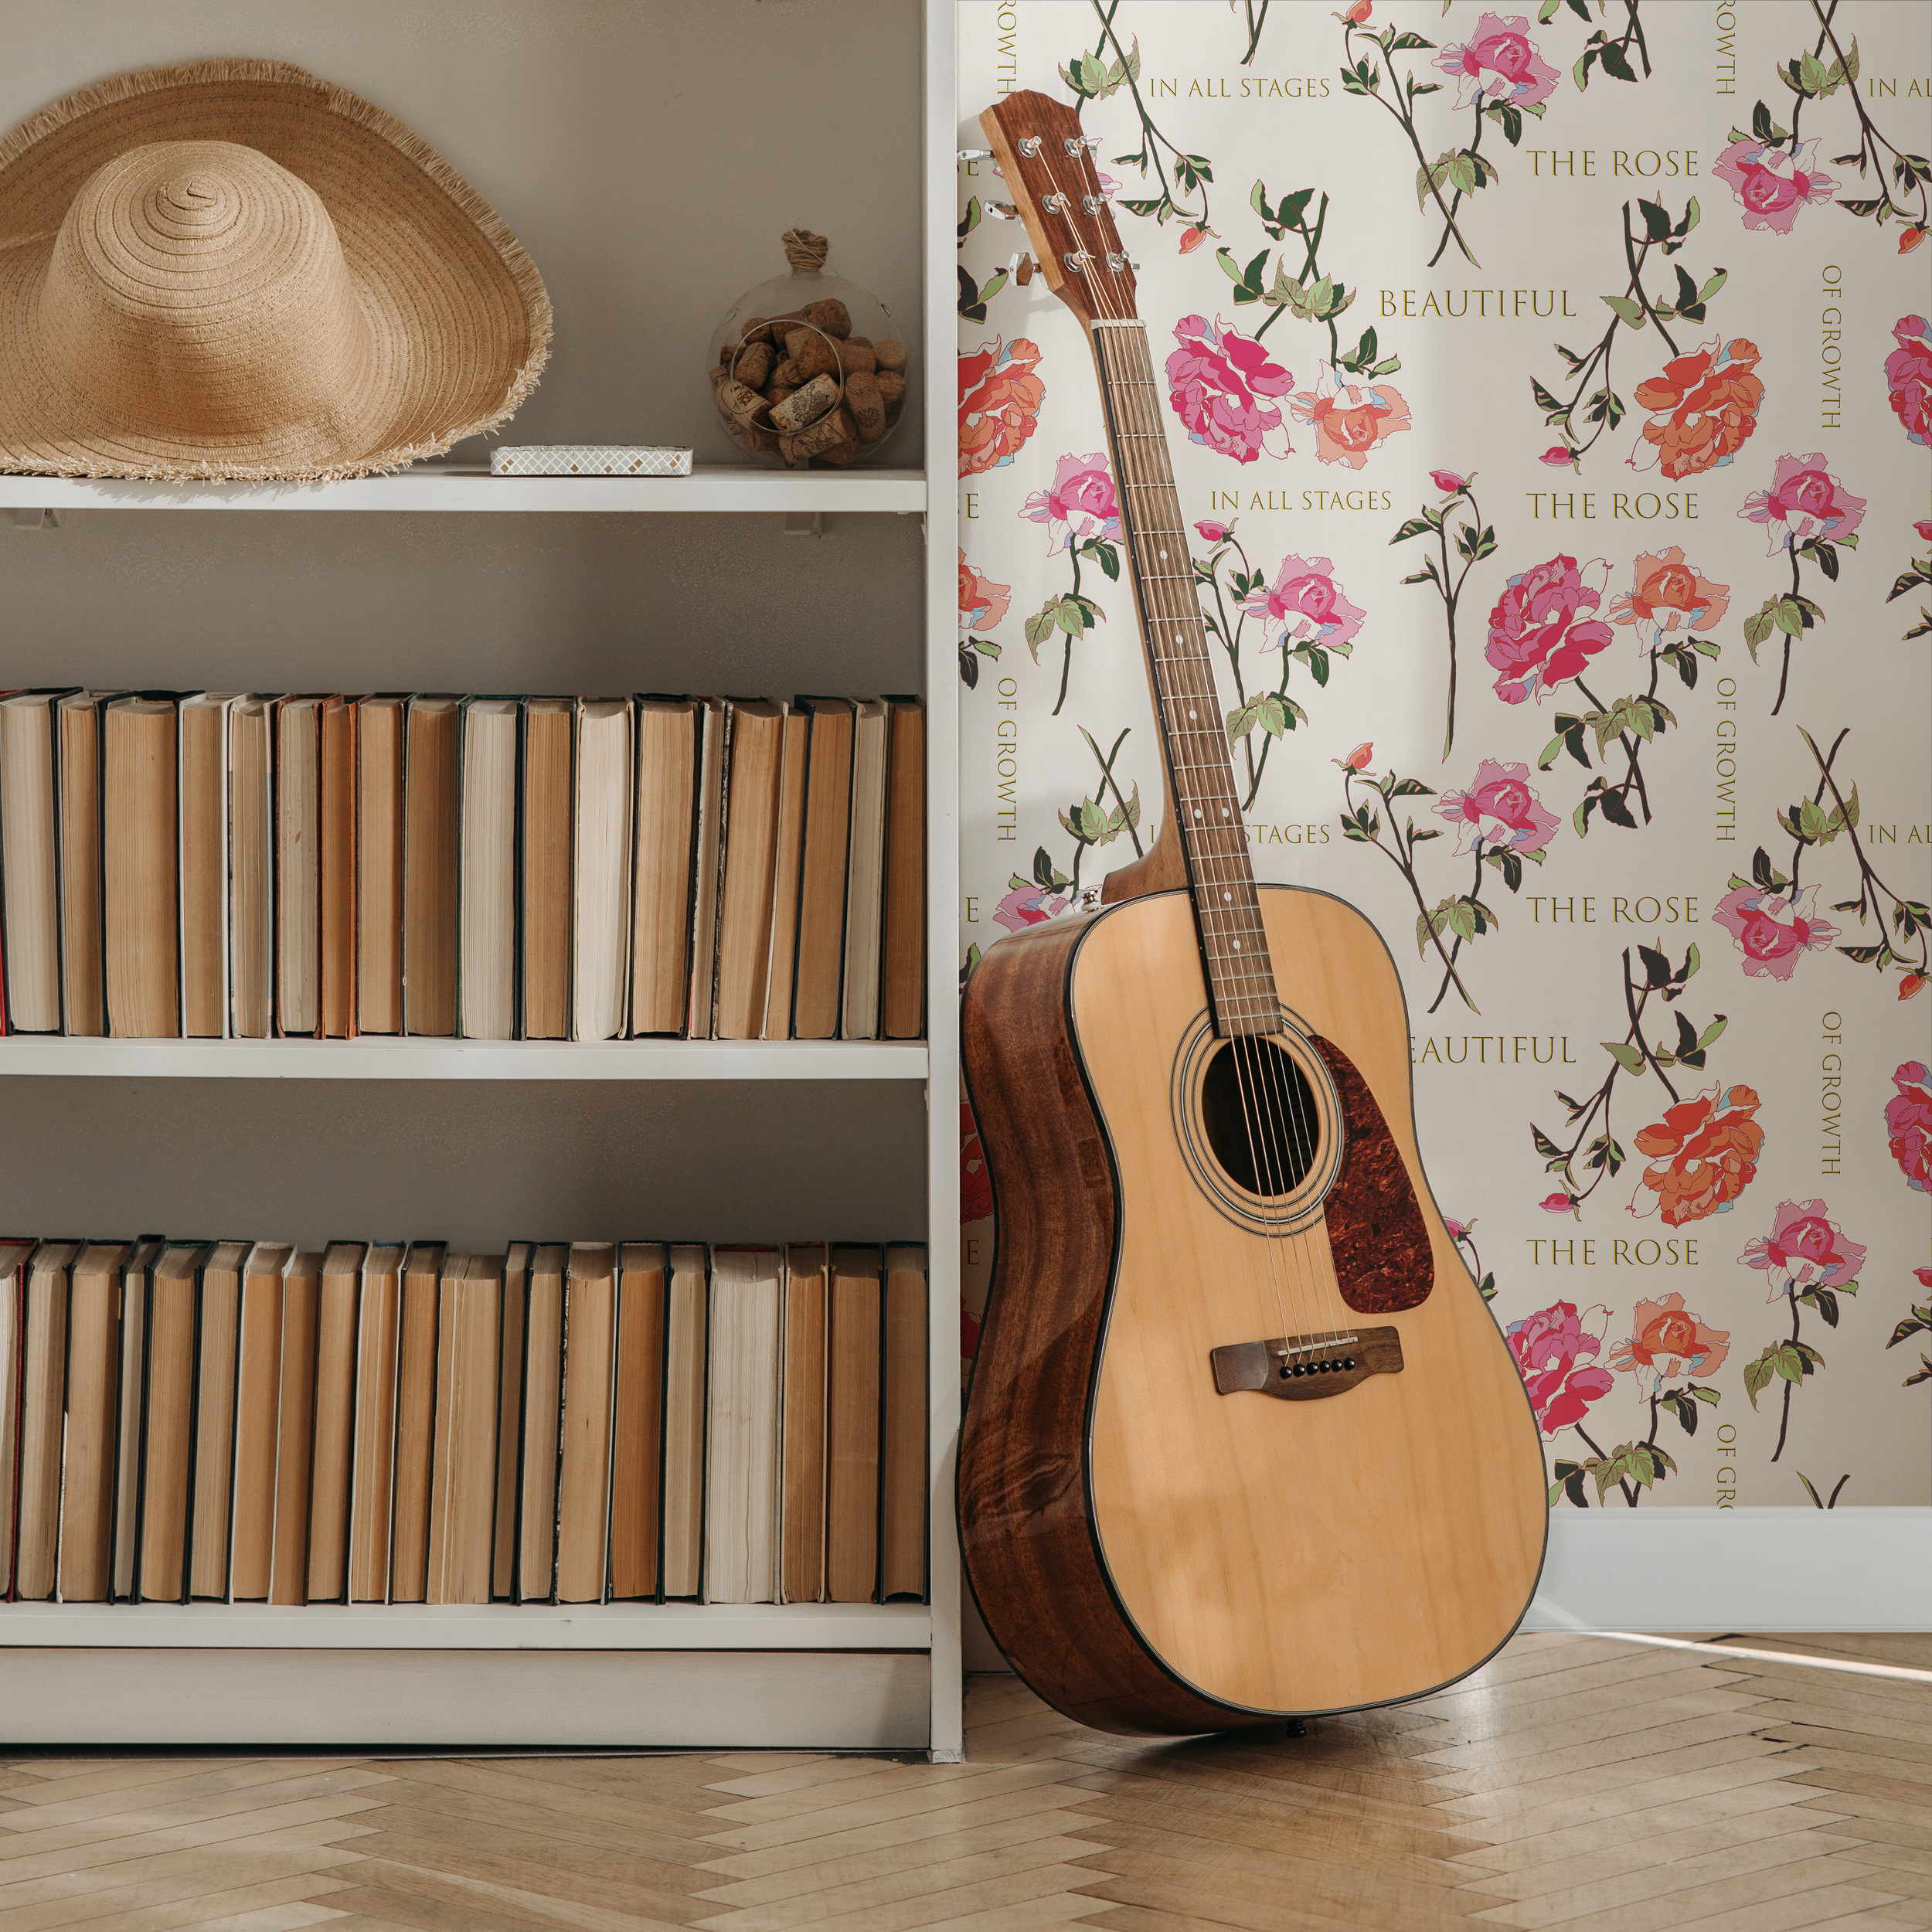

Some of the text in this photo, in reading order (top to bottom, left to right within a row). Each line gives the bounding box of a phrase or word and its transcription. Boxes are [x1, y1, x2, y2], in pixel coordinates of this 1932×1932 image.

[1150, 79, 1329, 97] IN ALL STAGES
[1869, 79, 1896, 97] IN
[1526, 151, 1698, 176] THE ROSE
[1379, 291, 1577, 317] BEAUTIFUL
[1821, 265, 1842, 428] OF GROWTH
[1211, 492, 1390, 510] IN ALL STAGES
[1526, 493, 1698, 519] THE ROSE
[997, 678, 1017, 842] OF GROWTH
[1716, 678, 1736, 842] OF GROWTH
[1869, 825, 1896, 844] IN
[1526, 897, 1698, 923] THE ROSE
[1821, 1012, 1842, 1175] OF GROWTH
[1526, 1240, 1698, 1266] THE ROSE
[1717, 1424, 1736, 1457] OF
